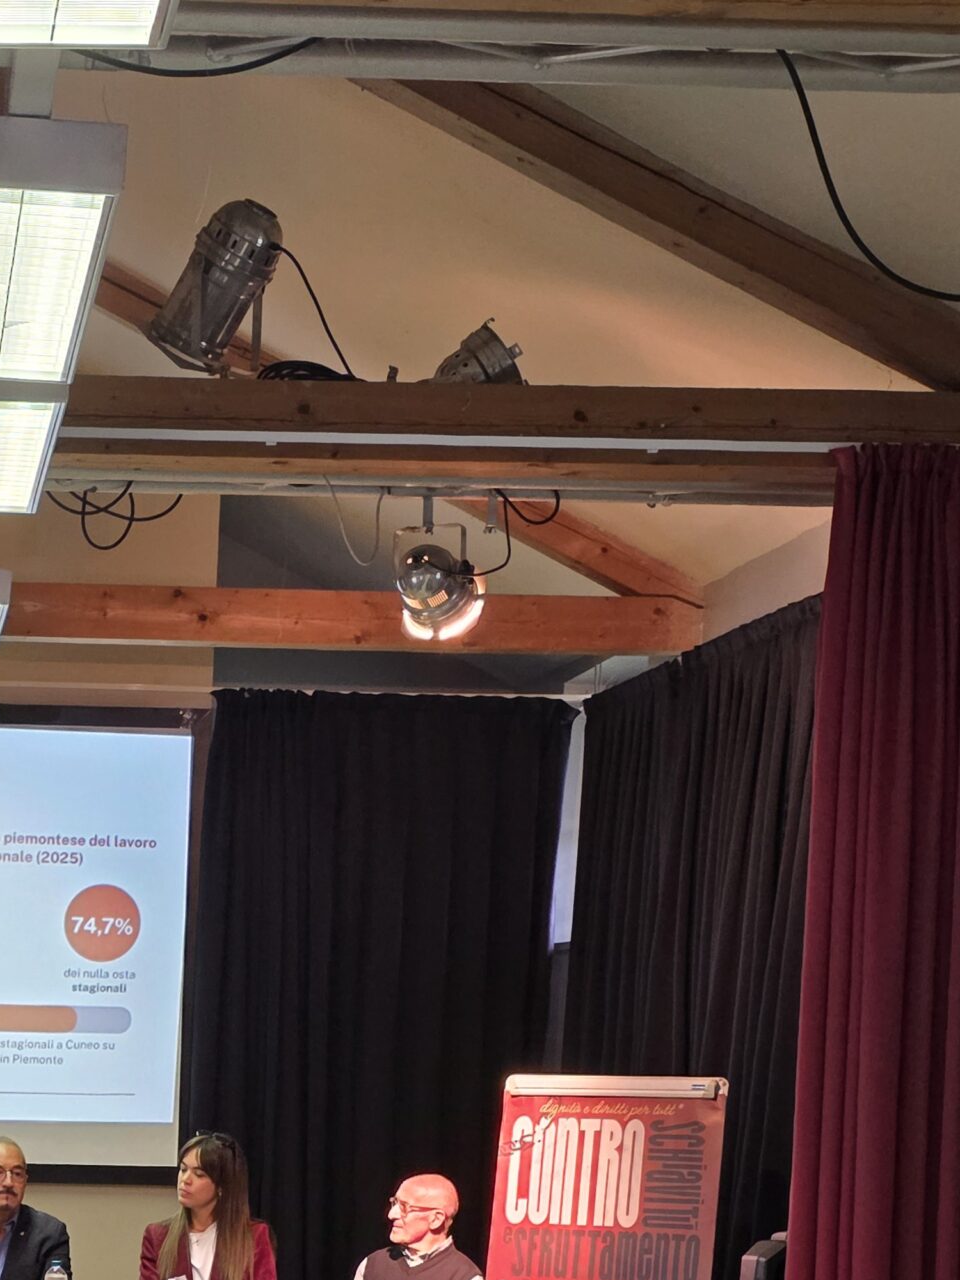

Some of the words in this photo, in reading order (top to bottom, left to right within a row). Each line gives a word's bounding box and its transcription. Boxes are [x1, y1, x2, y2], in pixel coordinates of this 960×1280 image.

[4, 831, 86, 847] piemontese
[89, 834, 110, 847] del
[114, 835, 157, 849] lavoro
[36, 851, 84, 867] (2025)
[70, 916, 133, 936] 74,7%
[63, 968, 82, 979] dei
[83, 969, 109, 979] nulla
[112, 970, 136, 980] osta
[71, 982, 127, 994] stagionali
[0, 1039, 54, 1051] stagionali
[56, 1042, 63, 1050] a
[65, 1040, 100, 1050] Cuneo
[102, 1042, 115, 1050] su
[0, 1055, 10, 1064] in
[13, 1055, 64, 1066] Piemonte
